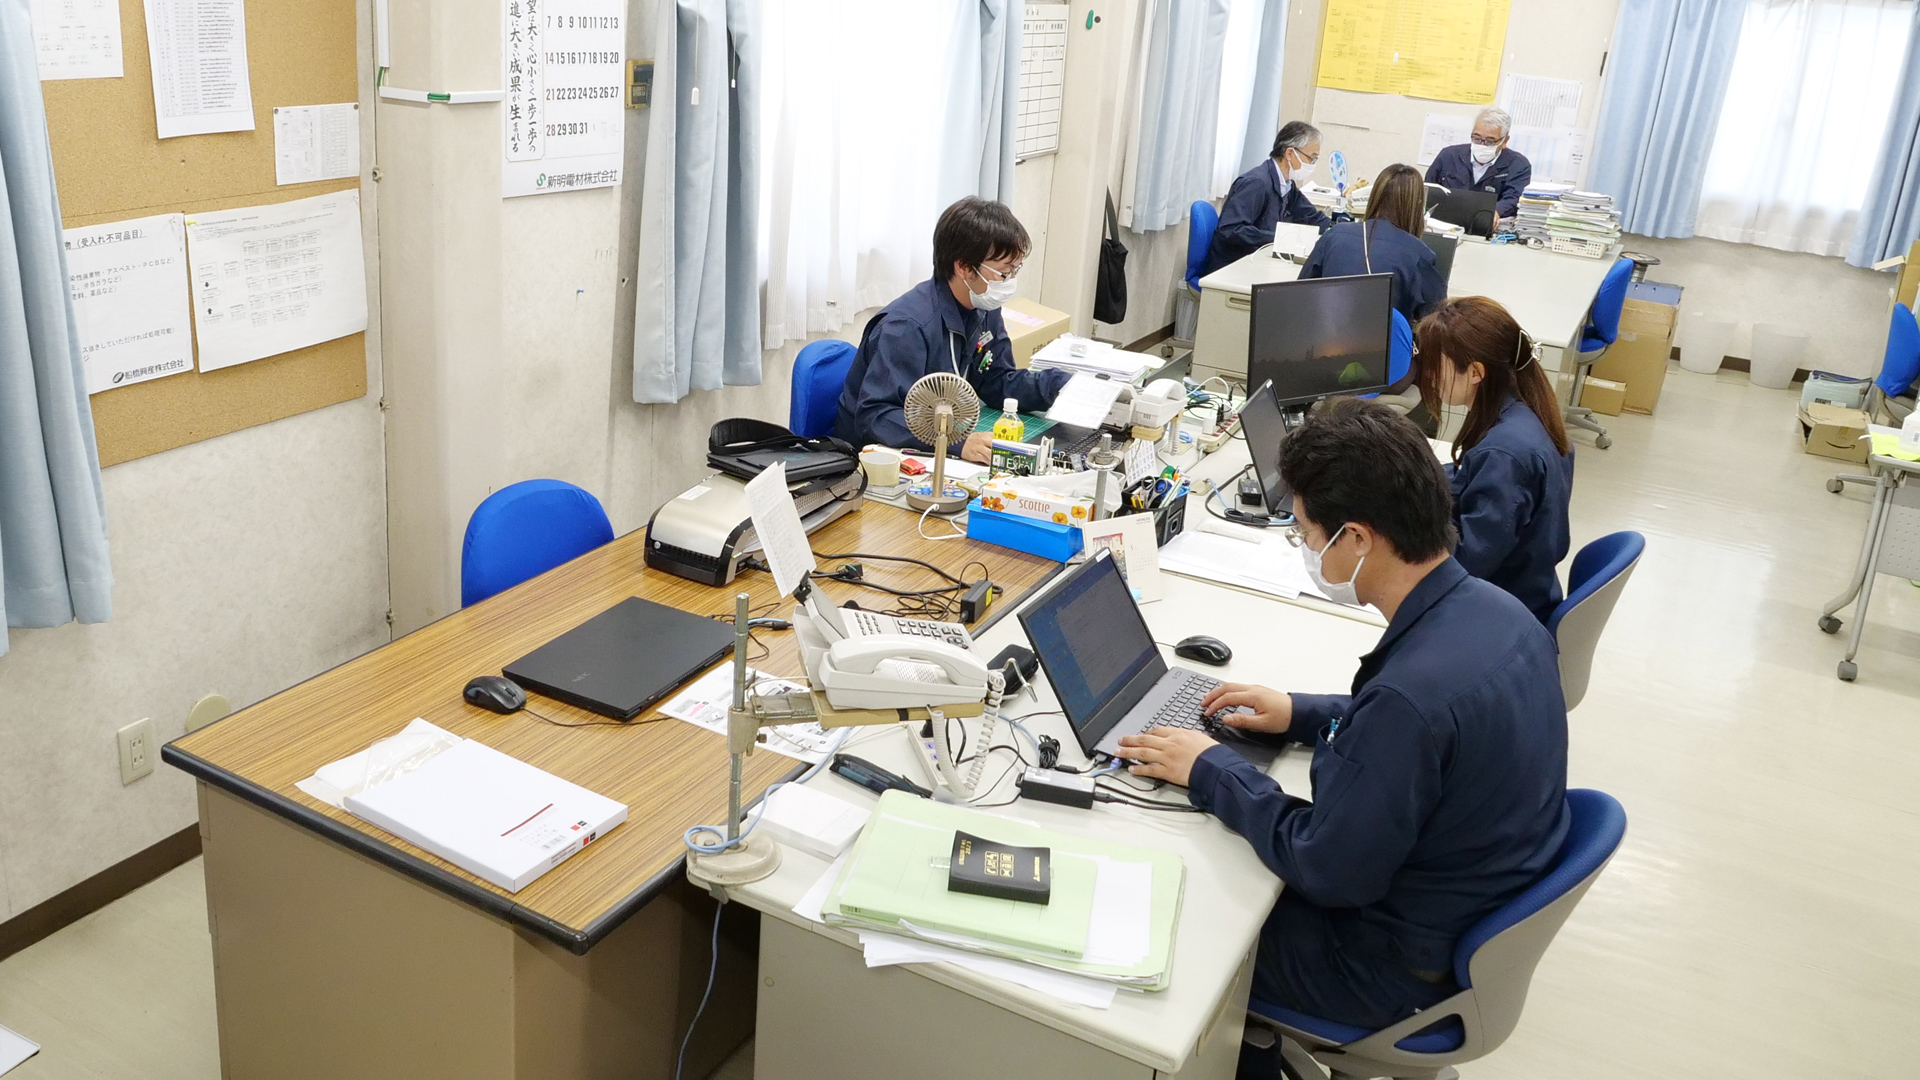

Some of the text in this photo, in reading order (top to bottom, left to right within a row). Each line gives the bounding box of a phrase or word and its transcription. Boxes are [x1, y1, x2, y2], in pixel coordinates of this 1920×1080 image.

[547, 16, 619, 29] 7 8 9 10 11 12 13
[545, 52, 619, 64] 14 15 16 17 18 19 20
[546, 88, 555, 100] 21
[556, 88, 566, 100] 22
[567, 88, 576, 99] 23
[579, 87, 587, 99] 24
[589, 87, 598, 99] 25
[599, 87, 609, 98] 26
[610, 86, 619, 98] 27
[546, 122, 588, 136] 28 29 30 31
[547, 169, 618, 188] 新明電材株式会社
[125, 359, 184, 380] 船橋興産株式会社
[1019, 499, 1050, 513] scottie
